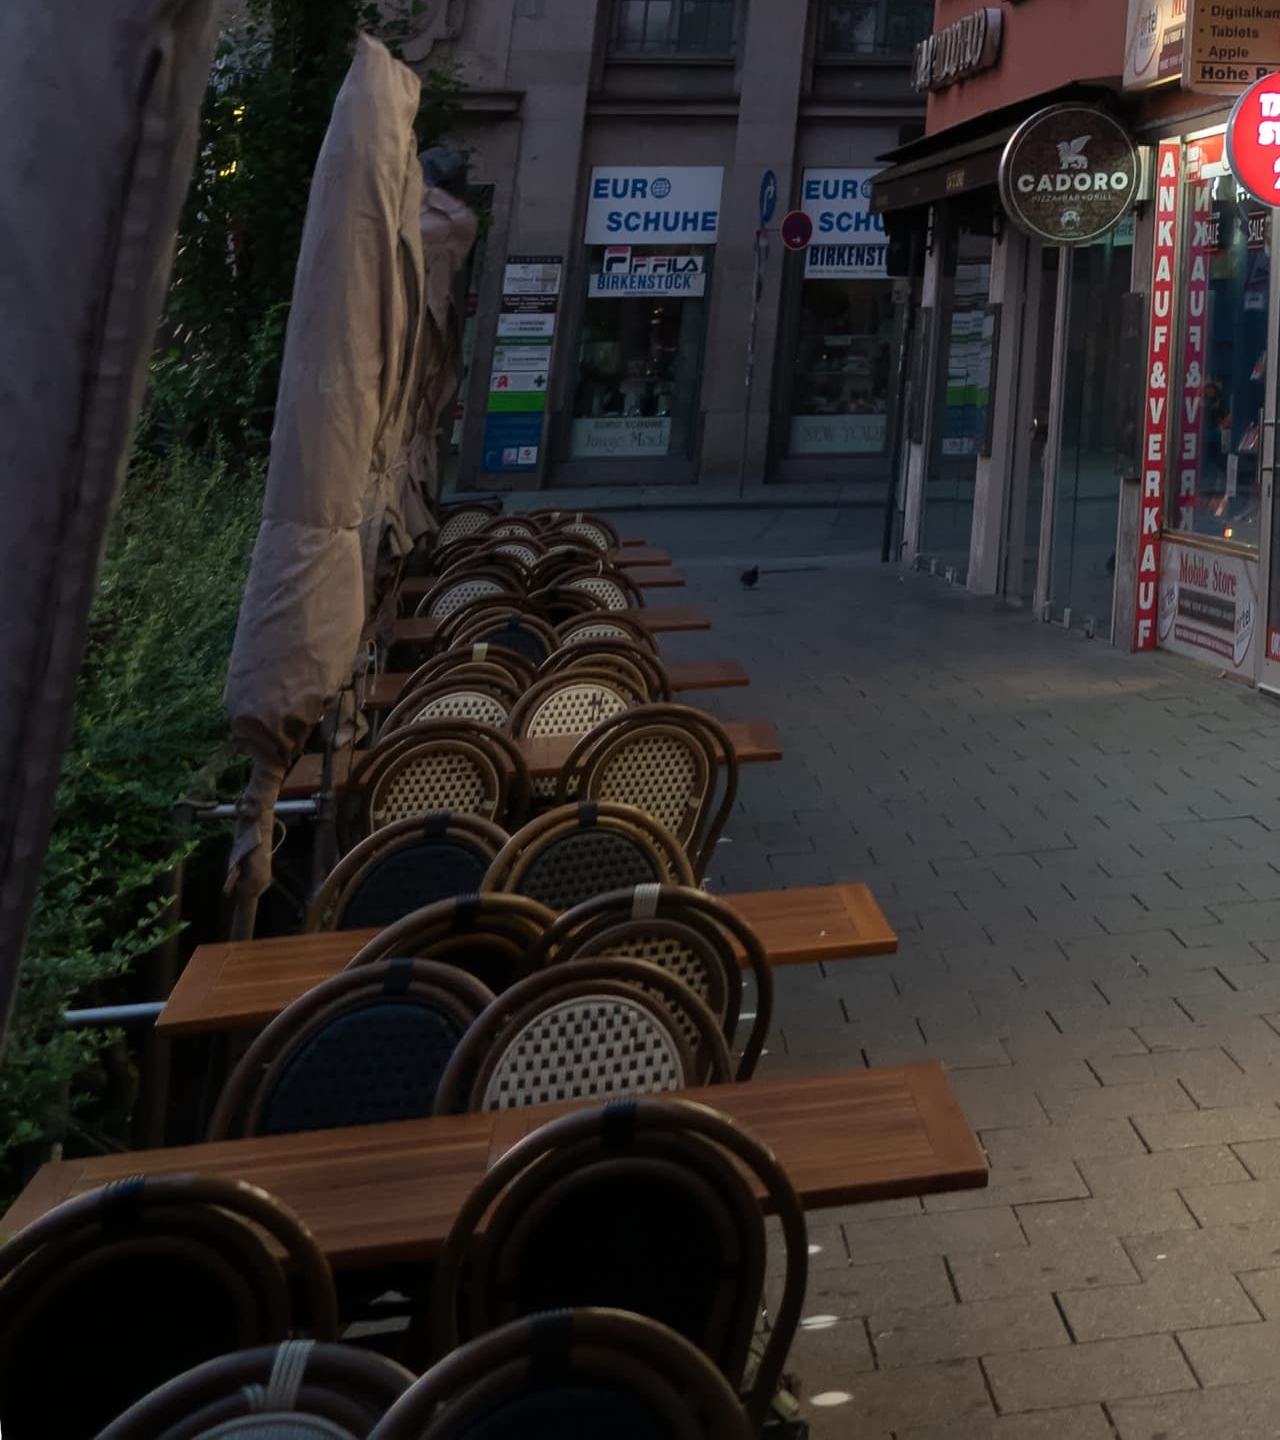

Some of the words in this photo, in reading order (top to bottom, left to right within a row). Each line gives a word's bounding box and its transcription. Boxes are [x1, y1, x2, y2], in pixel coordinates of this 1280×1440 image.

[1209, 25, 1260, 39] Tablets
[1208, 45, 1249, 59] Apple
[1201, 65, 1250, 80] Hohe
[606, 211, 718, 233] SCHUHE
[652, 257, 699, 273] FILA
[596, 274, 692, 291] BIRKENSTOCK
[1179, 551, 1209, 589] Mobile
[1212, 560, 1242, 596] Store
